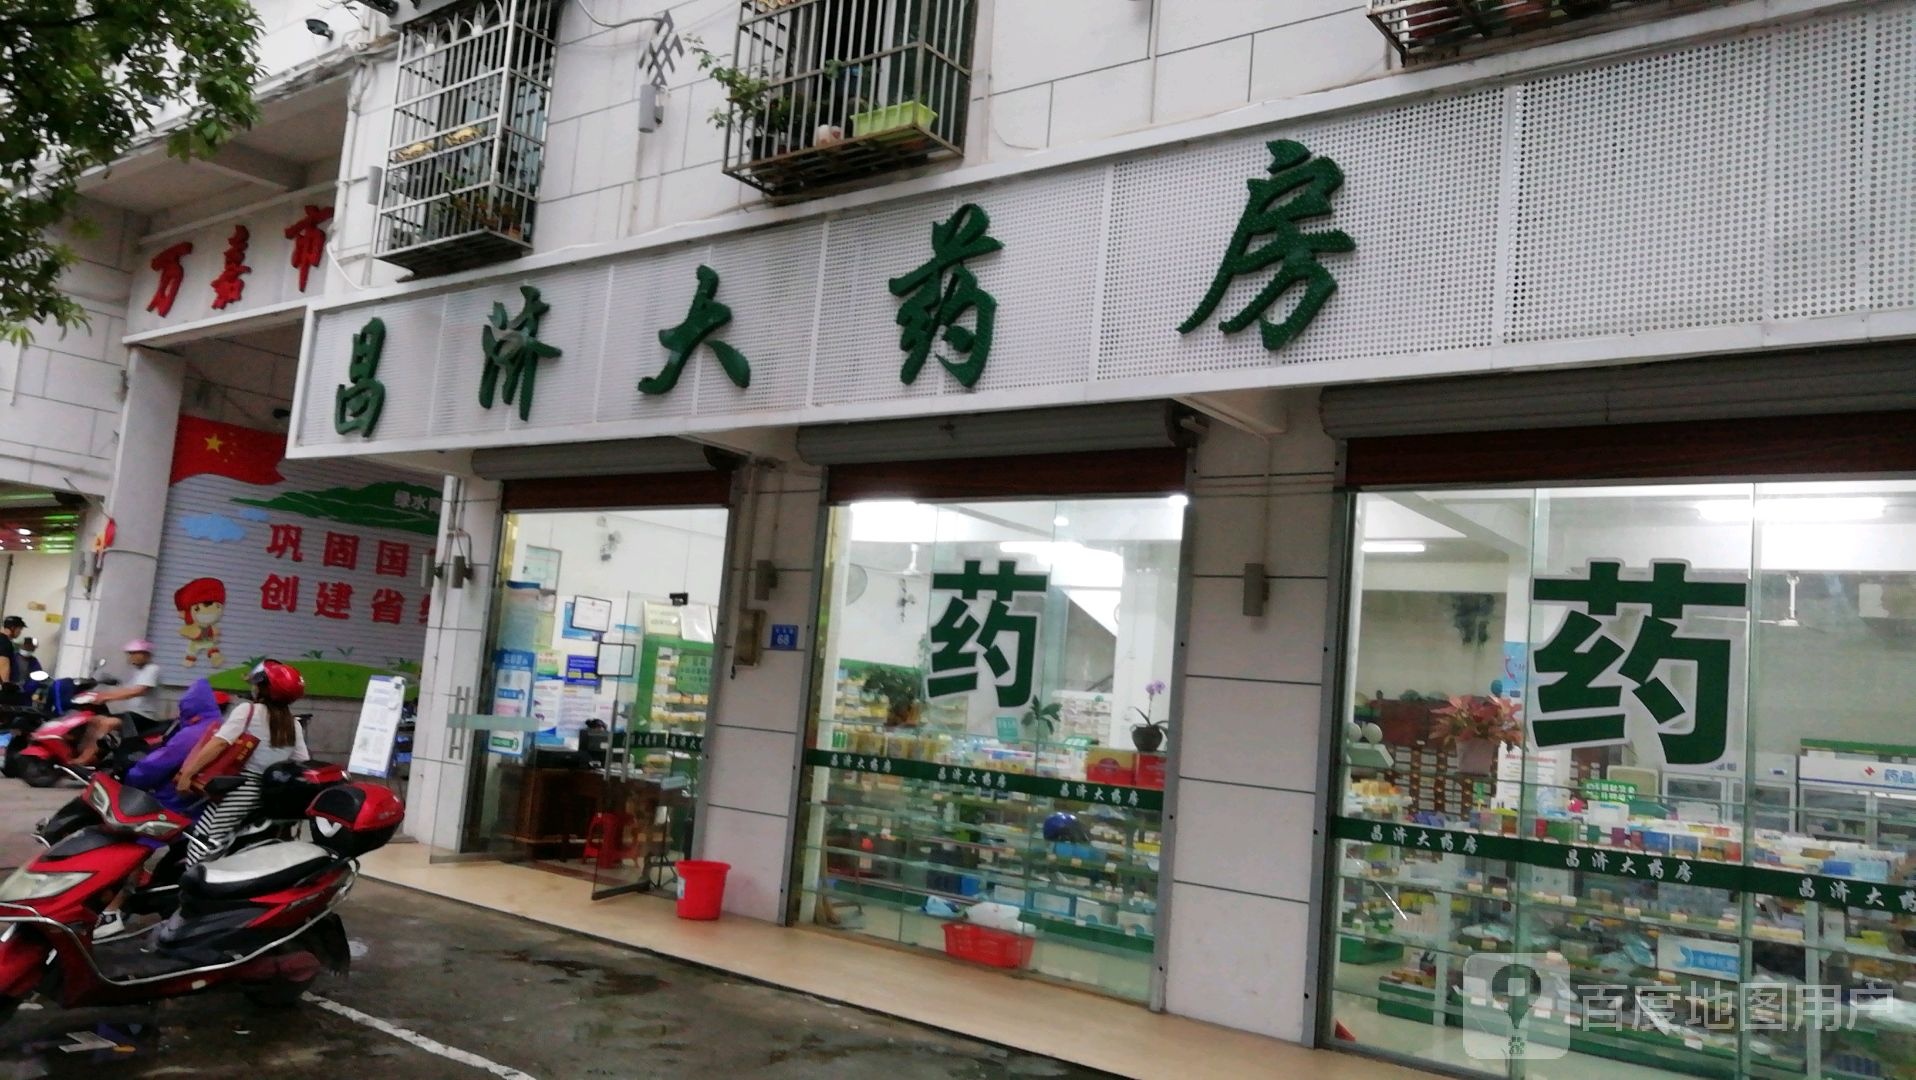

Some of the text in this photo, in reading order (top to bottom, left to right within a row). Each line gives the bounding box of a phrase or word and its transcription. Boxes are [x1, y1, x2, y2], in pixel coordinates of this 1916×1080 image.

[335, 138, 1357, 438] 昌济大药房
[266, 524, 436, 577] 巩固国
[928, 559, 1048, 708] 药
[1531, 561, 1748, 766] 药
[1370, 824, 1479, 856] 昌济大药房
[1566, 849, 1695, 883] 昌济大药房
